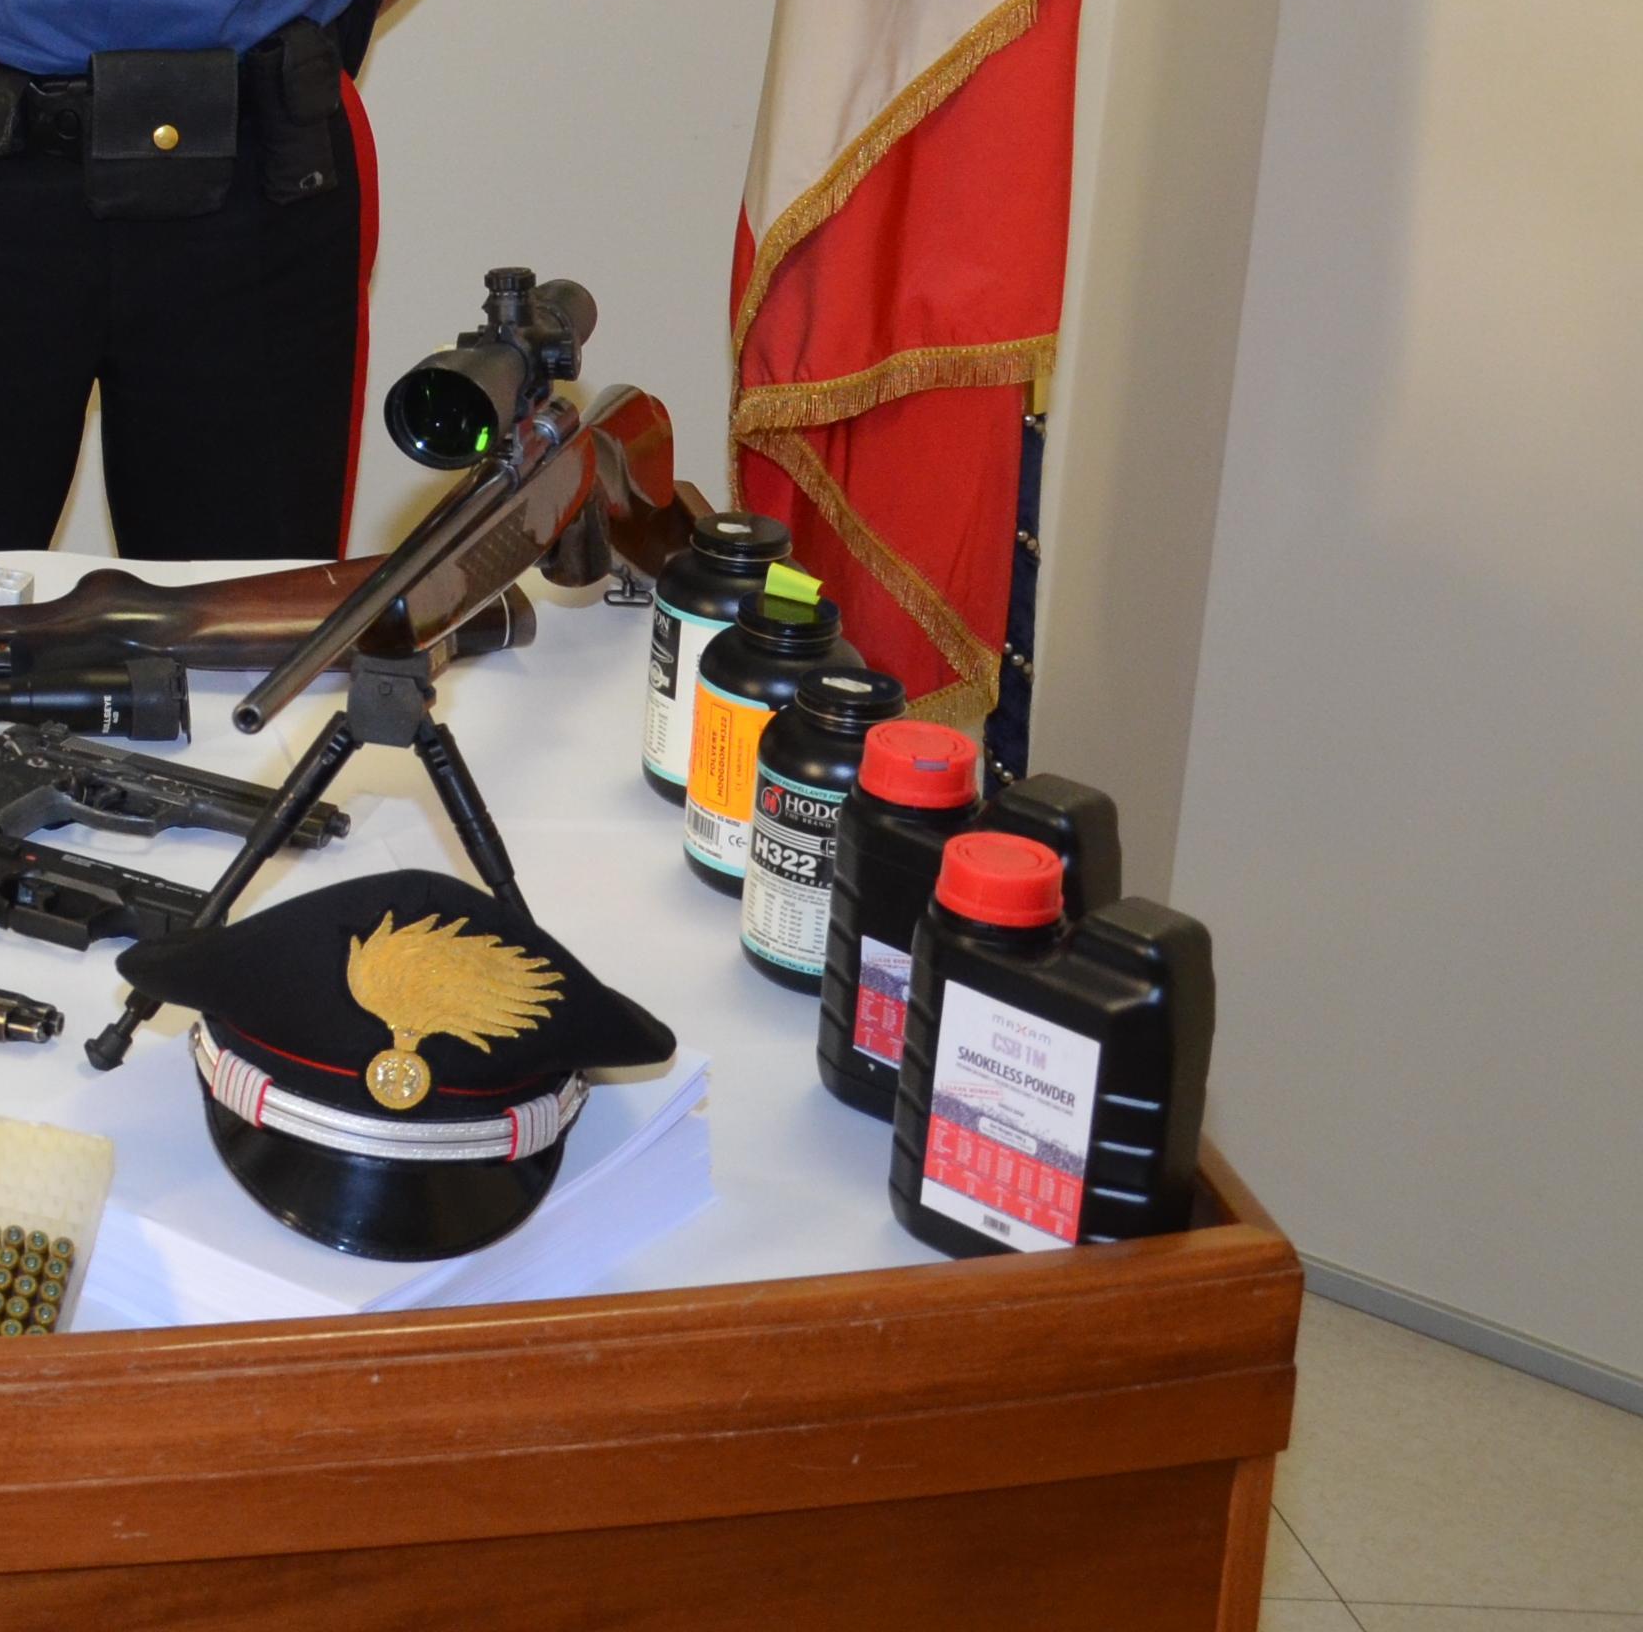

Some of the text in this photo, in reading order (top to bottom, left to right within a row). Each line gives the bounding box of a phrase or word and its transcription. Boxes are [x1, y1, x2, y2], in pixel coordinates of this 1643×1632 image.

[755, 832, 817, 878] H322
[957, 1046, 1023, 1085] SMOKELESS
[1024, 1073, 1076, 1108] POWDER
